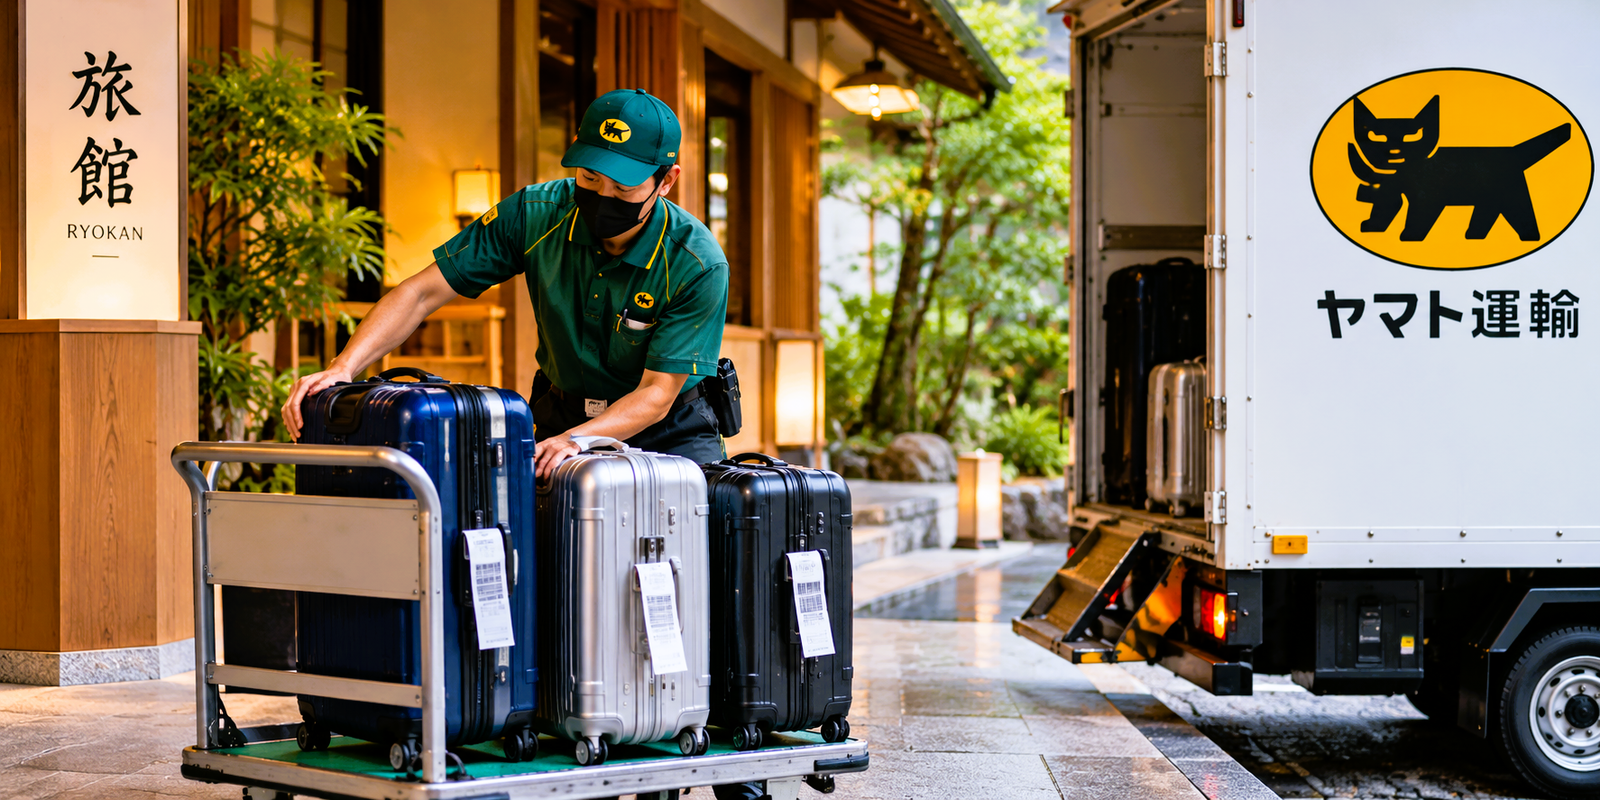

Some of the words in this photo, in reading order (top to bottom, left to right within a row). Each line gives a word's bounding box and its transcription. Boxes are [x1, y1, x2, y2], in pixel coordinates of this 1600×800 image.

[69, 50, 141, 208] 旅館
[67, 223, 143, 241] RYOKAN
[1317, 289, 1580, 339] ヤマト運輸
